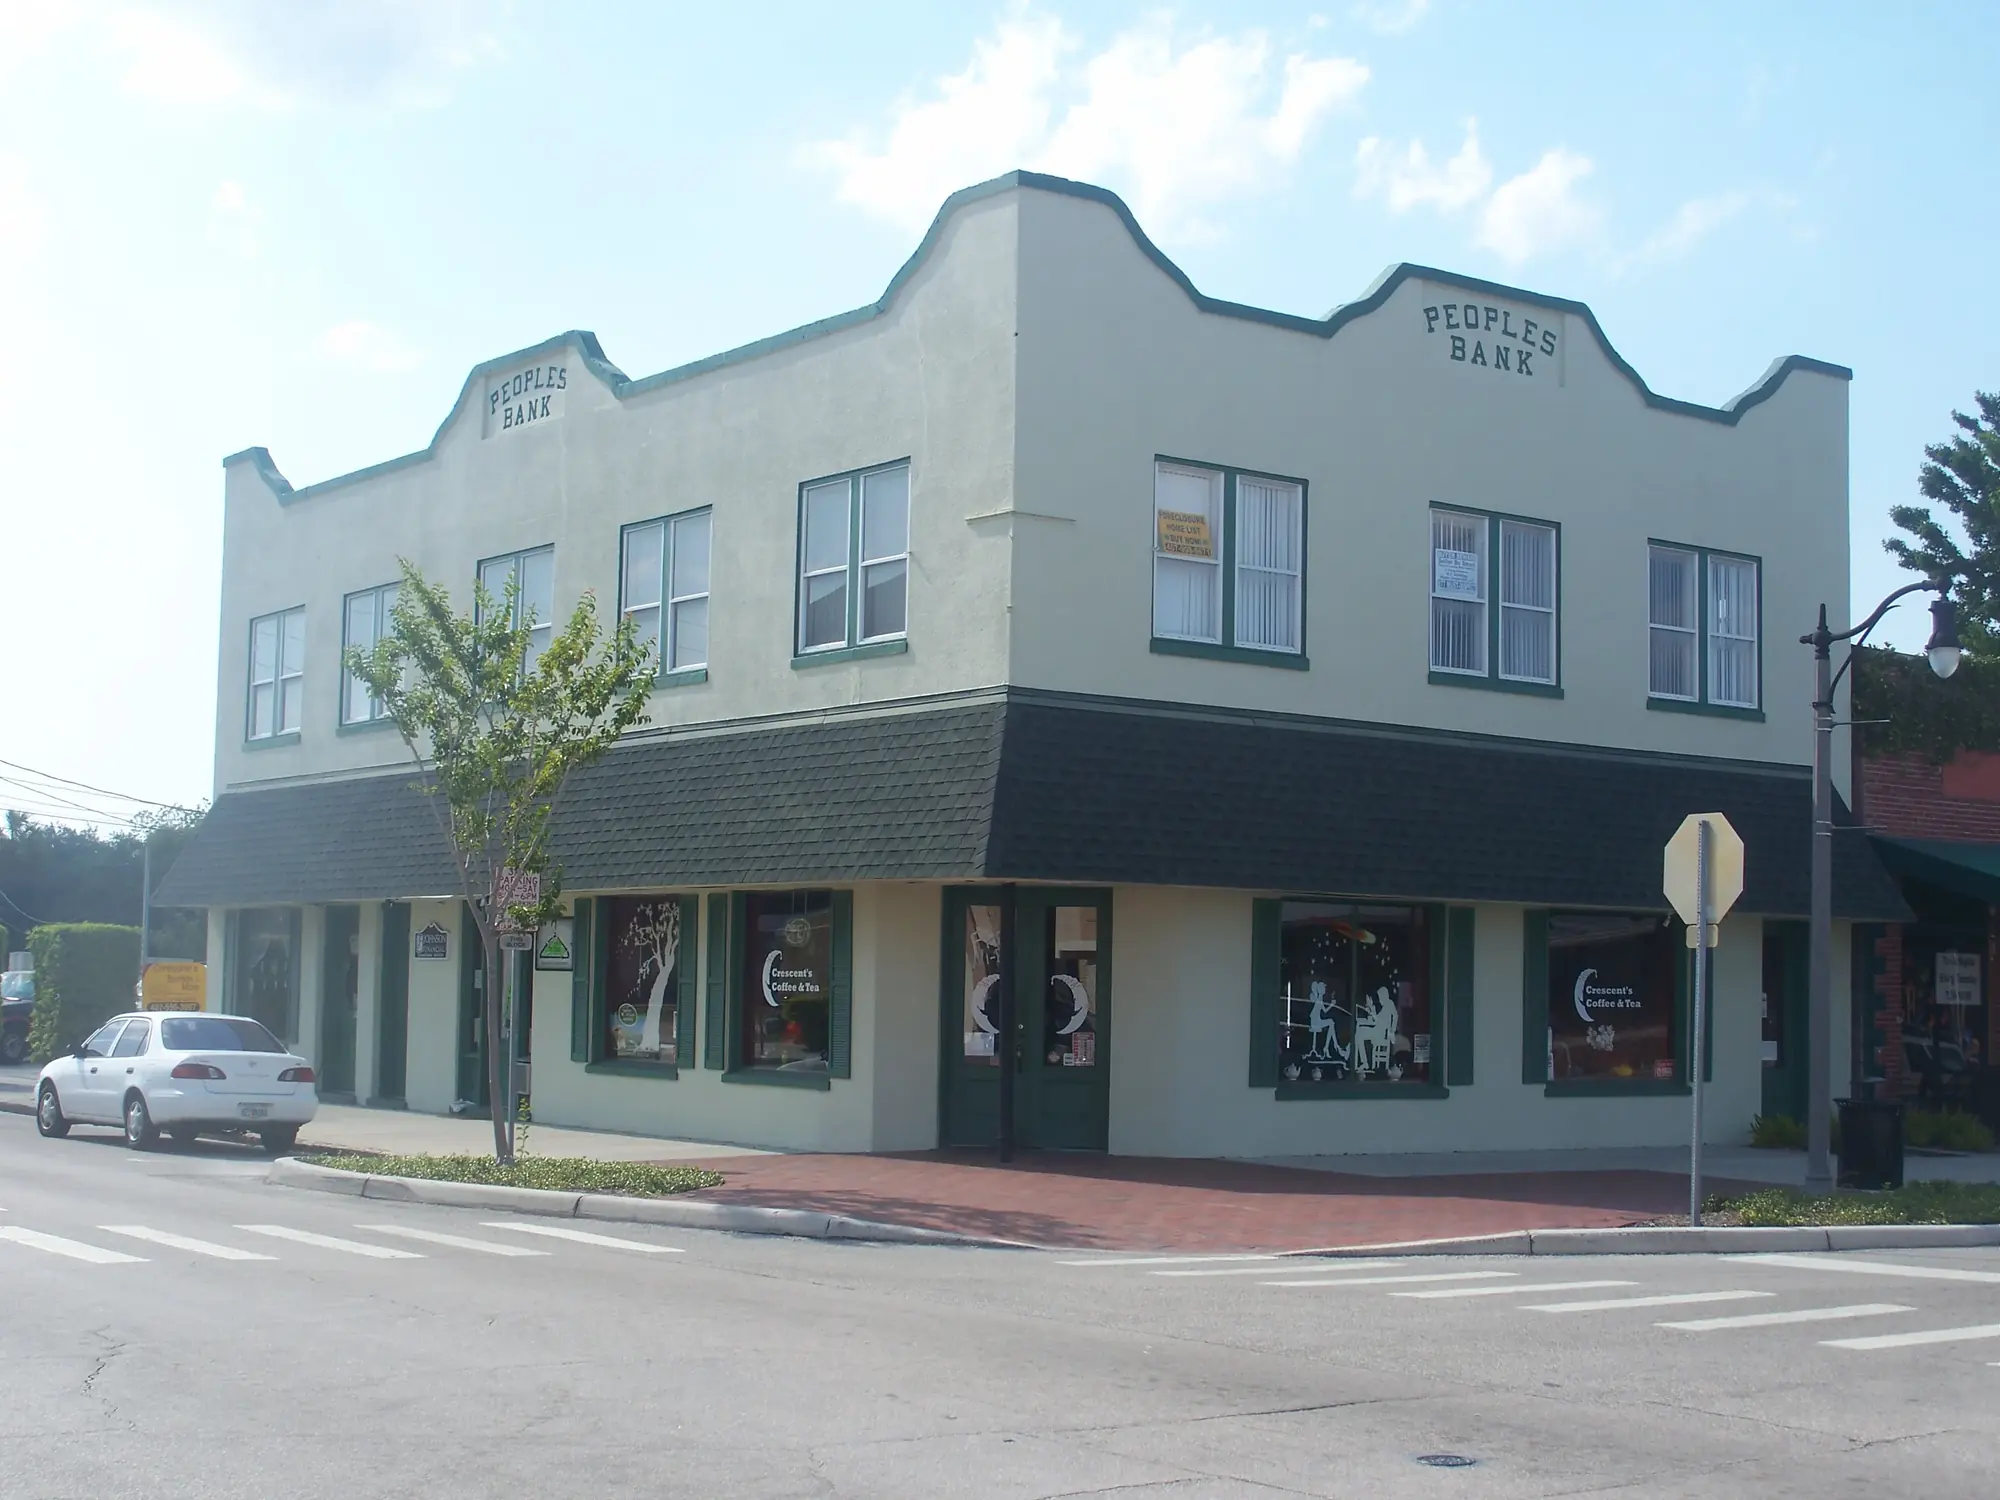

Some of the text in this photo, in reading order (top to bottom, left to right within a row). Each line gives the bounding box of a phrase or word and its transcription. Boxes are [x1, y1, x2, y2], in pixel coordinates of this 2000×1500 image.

[1423, 304, 1557, 357] PEOPLES
[1450, 335, 1533, 376] BANK
[490, 366, 567, 415] PEOPLES
[503, 395, 551, 430] BANK
[772, 968, 813, 978] Crescent's
[771, 982, 820, 992] Coffee & Tea
[1586, 985, 1633, 994] Crescent's
[1586, 999, 1642, 1008] Coffee & Tea
